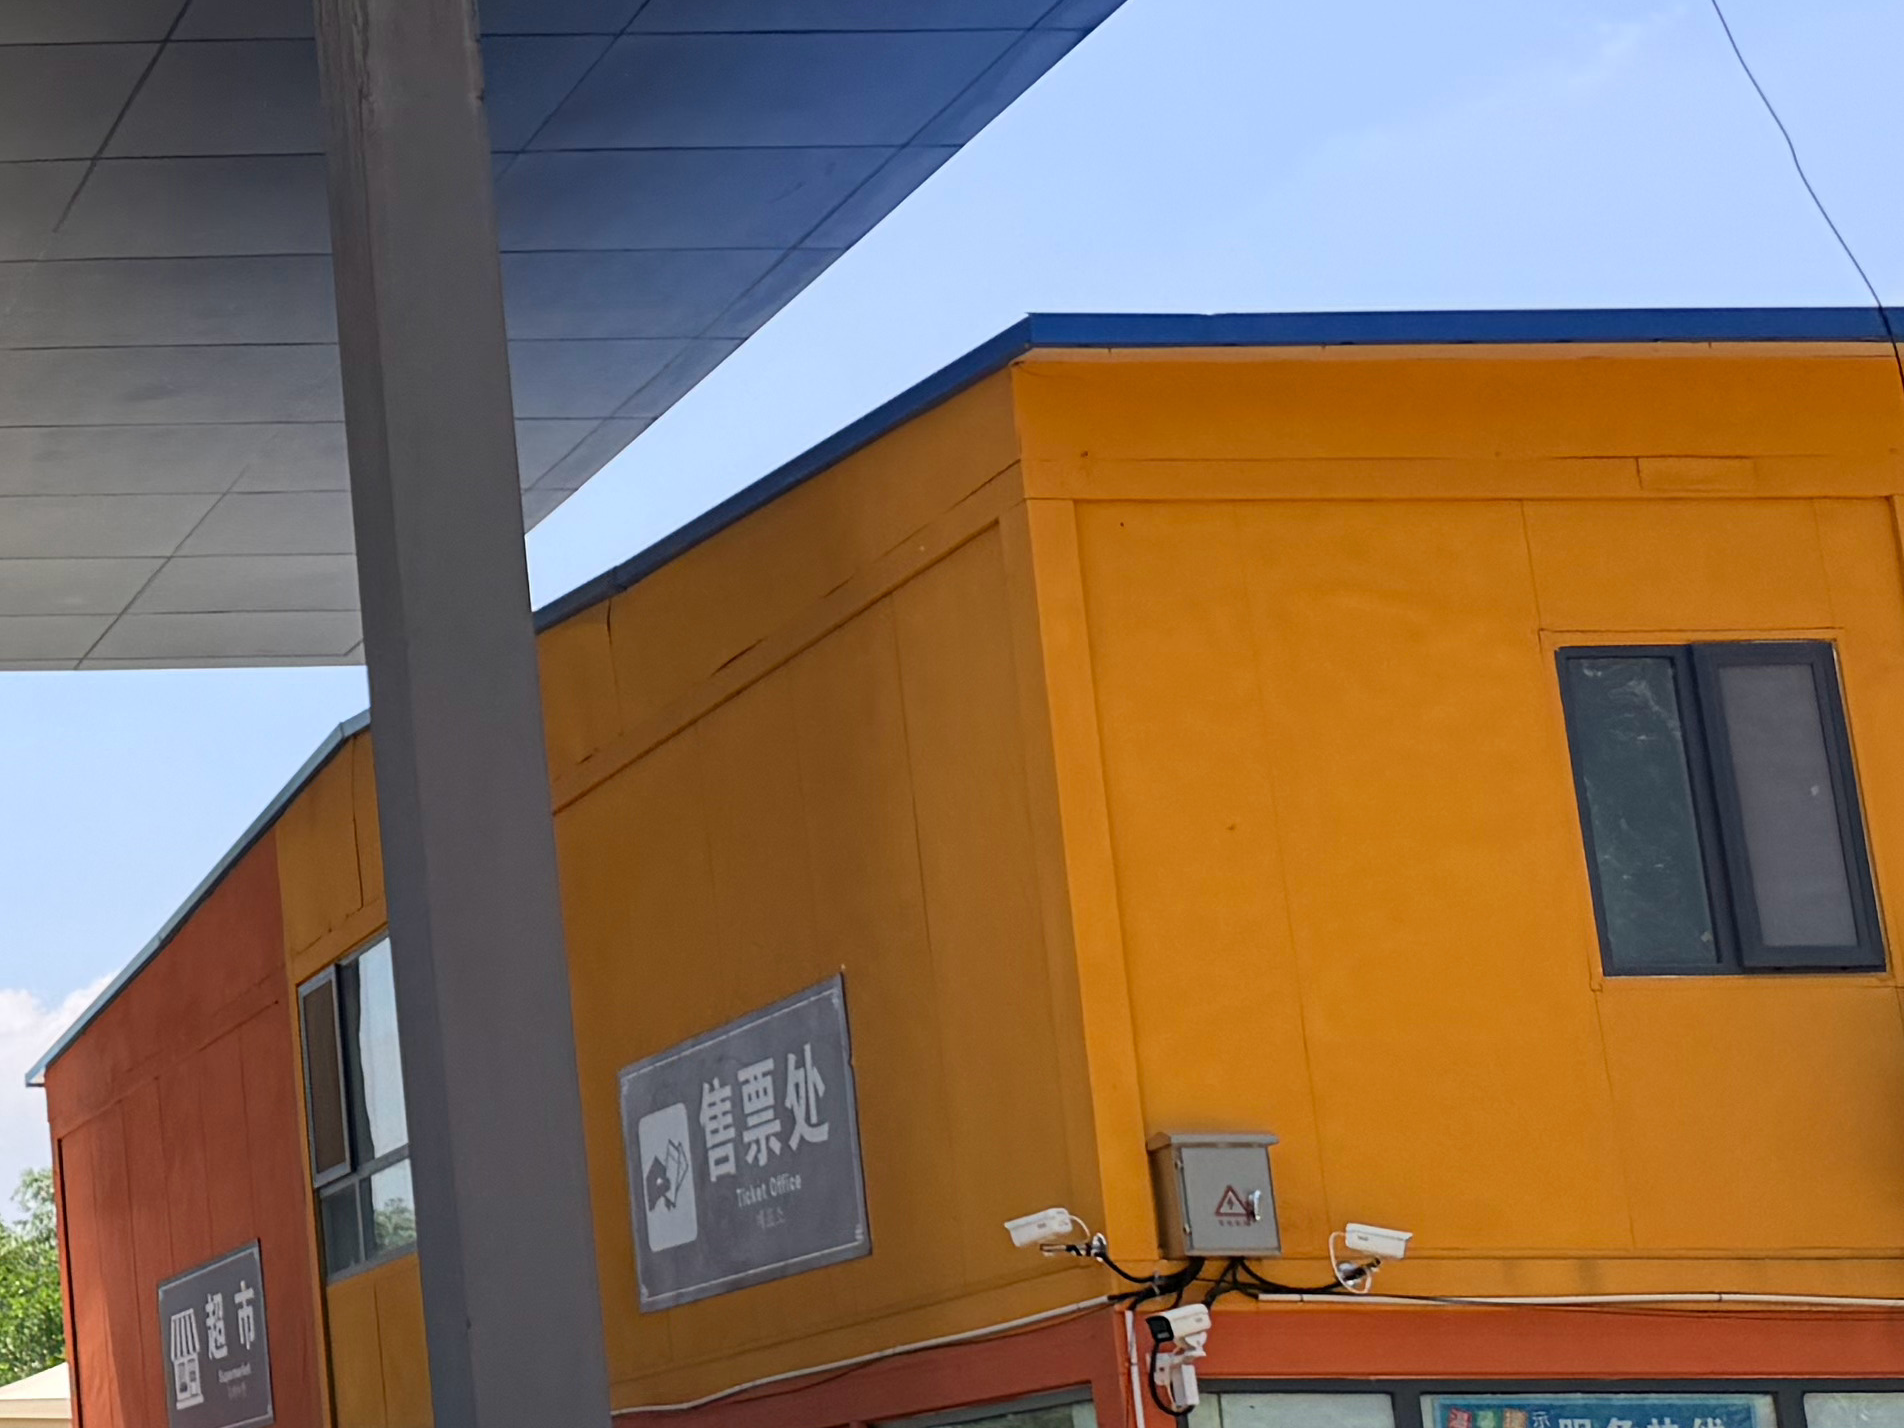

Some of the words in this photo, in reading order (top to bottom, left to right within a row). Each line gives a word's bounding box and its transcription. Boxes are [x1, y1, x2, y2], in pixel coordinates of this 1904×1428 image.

[699, 1042, 829, 1182] 售票处
[736, 1182, 769, 1208] Ticket
[769, 1173, 802, 1197] Office
[205, 1280, 255, 1361] 超市
